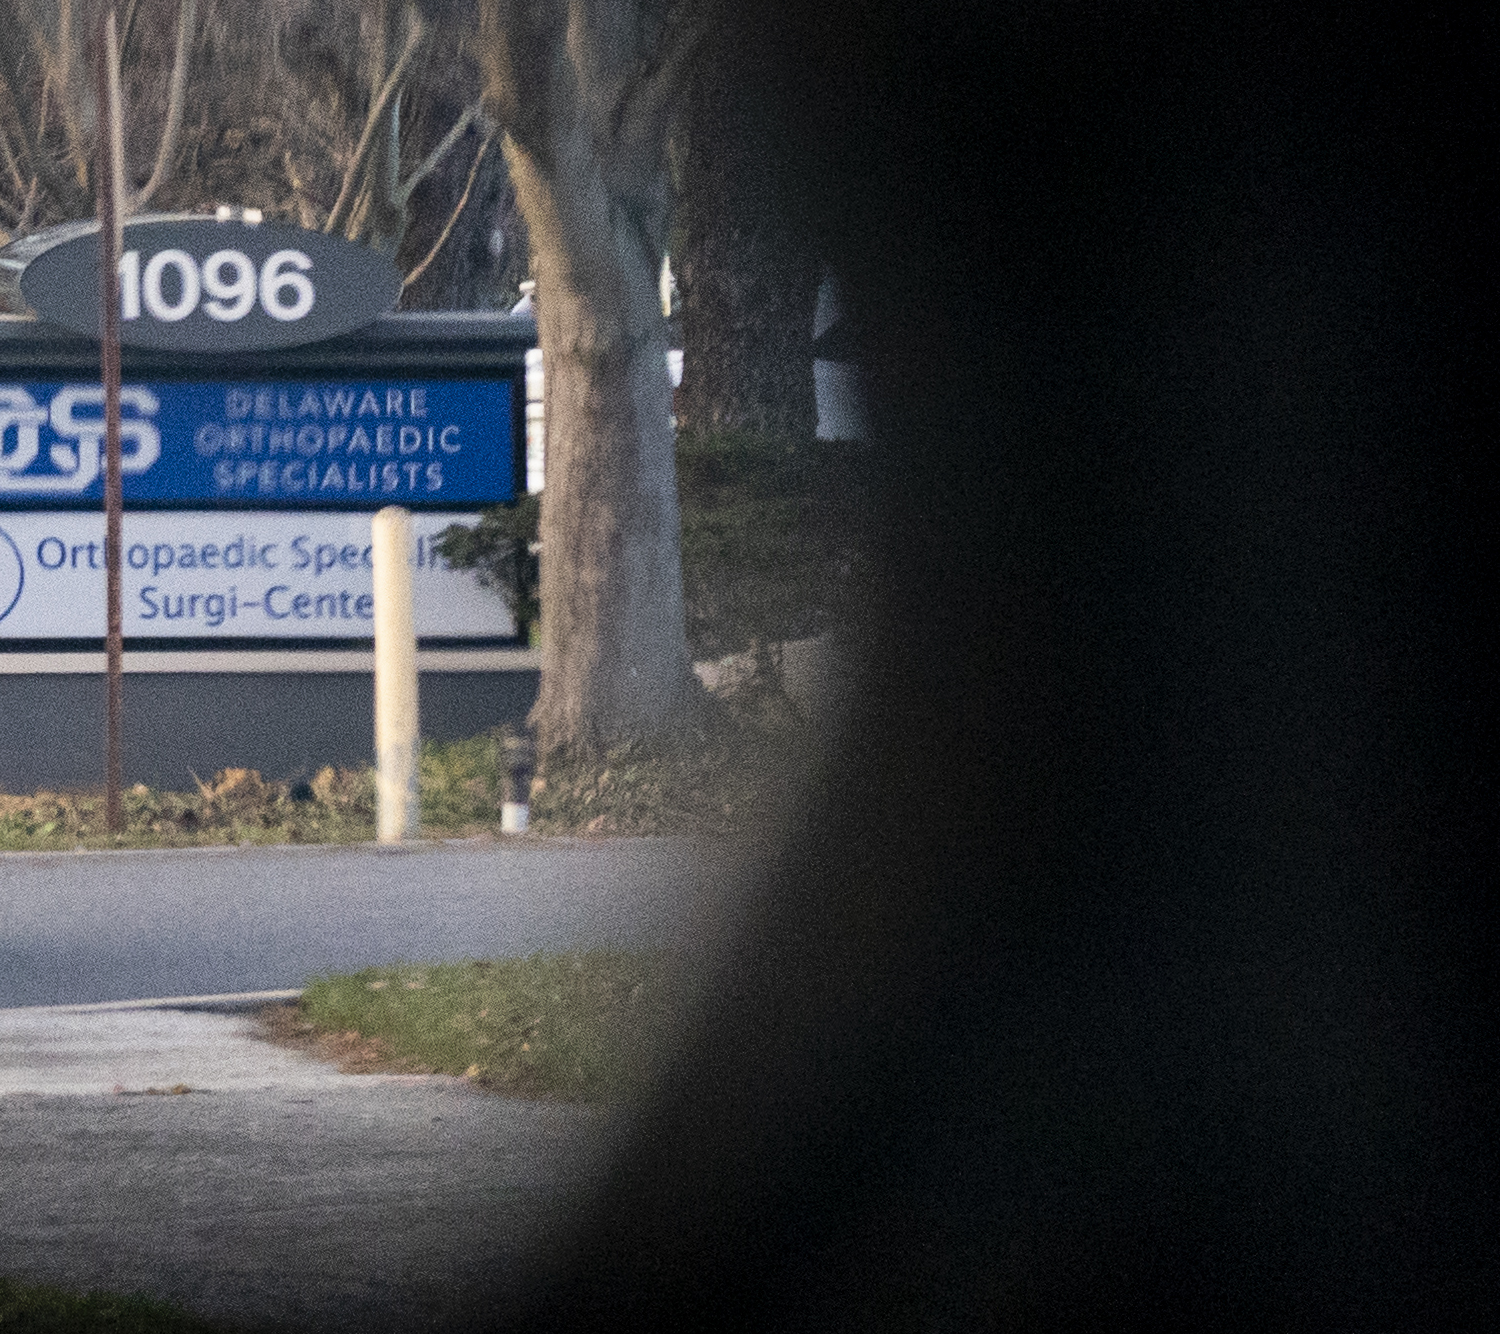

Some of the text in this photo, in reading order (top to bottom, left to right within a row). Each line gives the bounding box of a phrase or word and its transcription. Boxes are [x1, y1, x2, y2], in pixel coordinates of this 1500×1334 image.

[118, 248, 316, 322] 1096
[226, 387, 427, 418] DELAWARE
[194, 424, 461, 456] ORTHOPAEDIC
[213, 459, 443, 492] SPECIALISTS
[36, 535, 277, 576] Ortopaedic
[139, 584, 375, 627] Surgi-Cente
